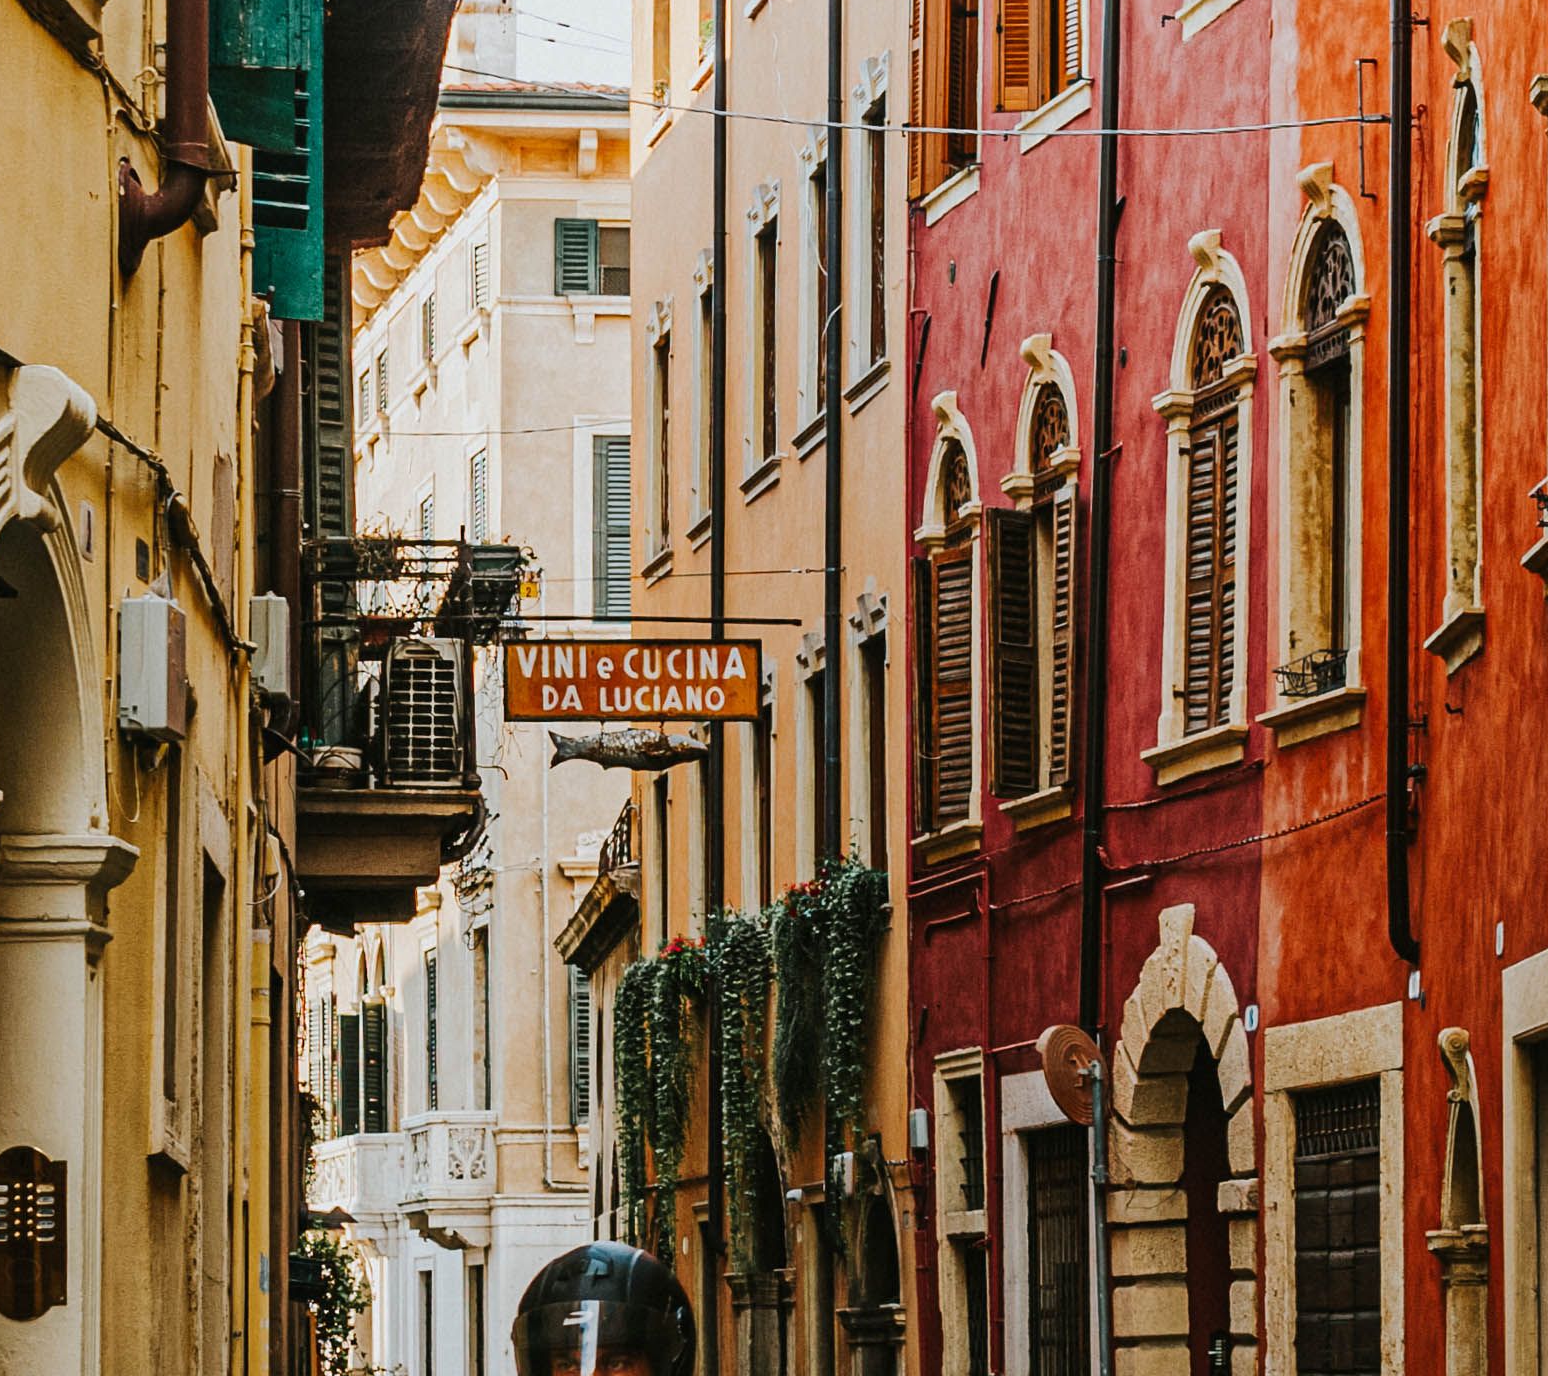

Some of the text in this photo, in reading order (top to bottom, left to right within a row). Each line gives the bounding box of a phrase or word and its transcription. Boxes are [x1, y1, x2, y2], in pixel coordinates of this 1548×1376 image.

[525, 586, 532, 598] 2
[516, 647, 746, 680] VINI e CUCINA
[542, 684, 725, 712] DA LUCIANO
